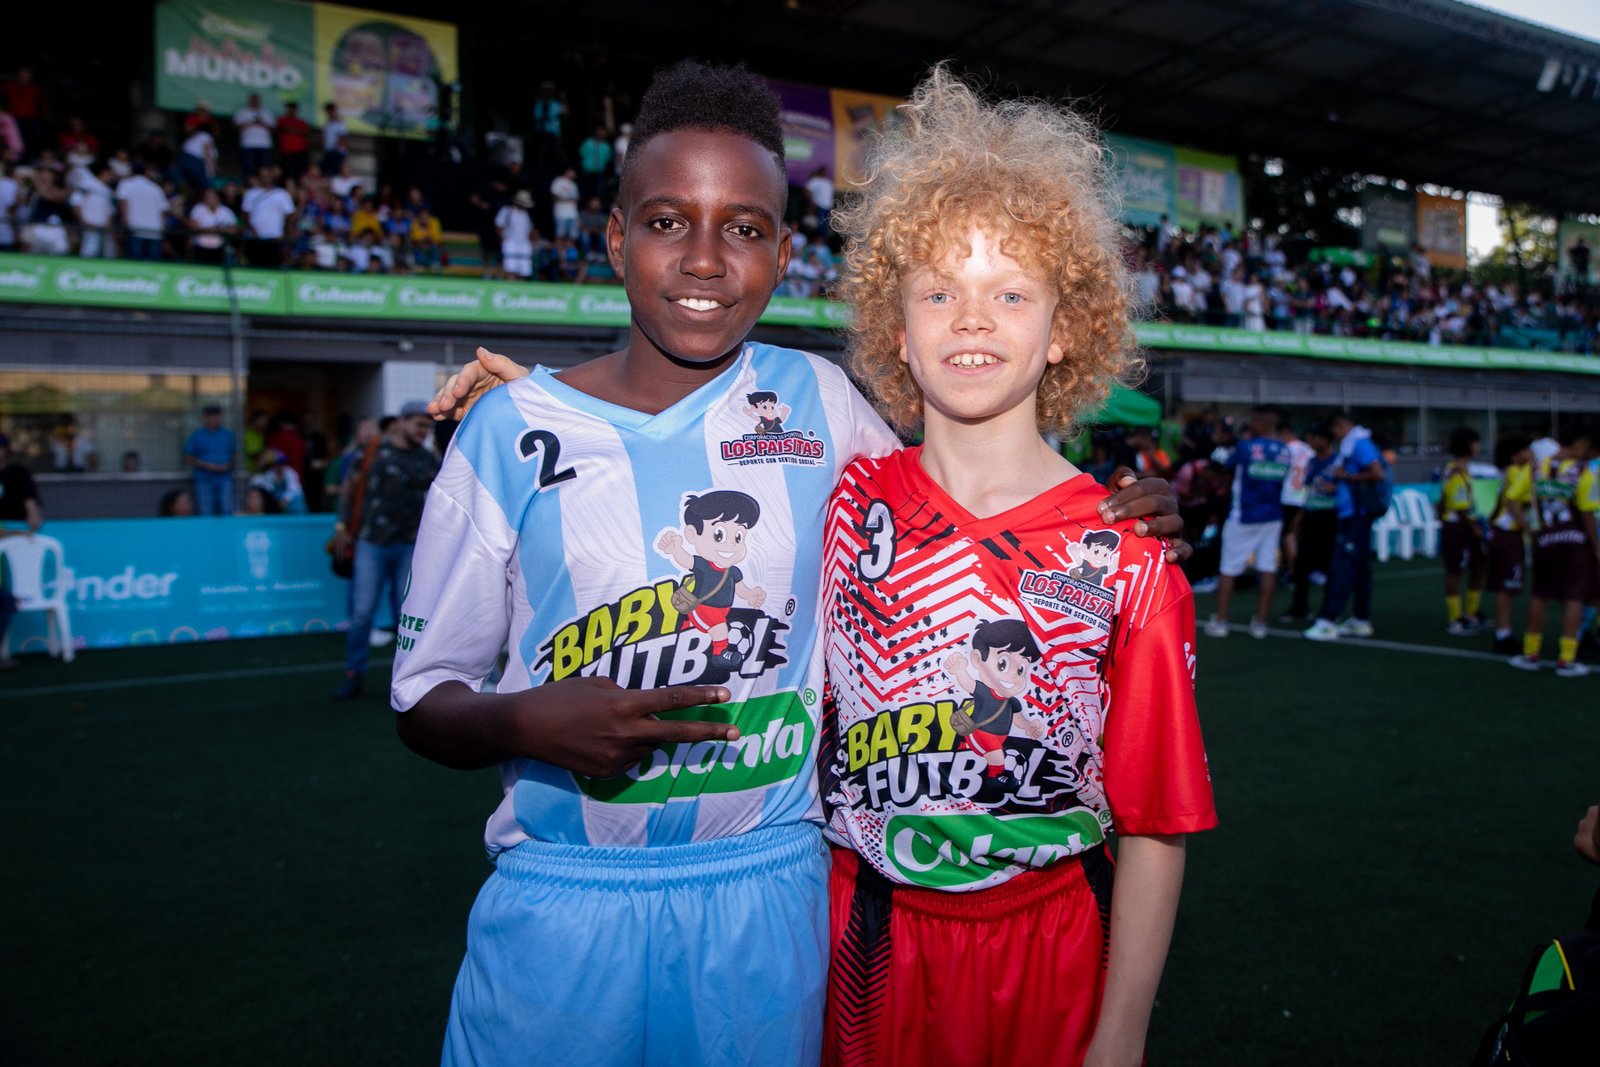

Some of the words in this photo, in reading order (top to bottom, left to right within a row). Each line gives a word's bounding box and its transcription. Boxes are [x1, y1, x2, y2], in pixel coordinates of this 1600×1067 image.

[165, 47, 301, 90] MUNDO
[520, 430, 577, 487] 2
[723, 441, 755, 458] LOS
[757, 438, 823, 457] PAISITAS
[860, 502, 895, 579] 3
[1023, 573, 1061, 597] LOS
[1034, 597, 1060, 610] DEPORTE
[1060, 605, 1073, 614] CON
[1074, 611, 1097, 626] SENTIDO
[554, 574, 695, 682] BABY
[624, 718, 805, 782] olanta
[848, 701, 974, 772] BABY
